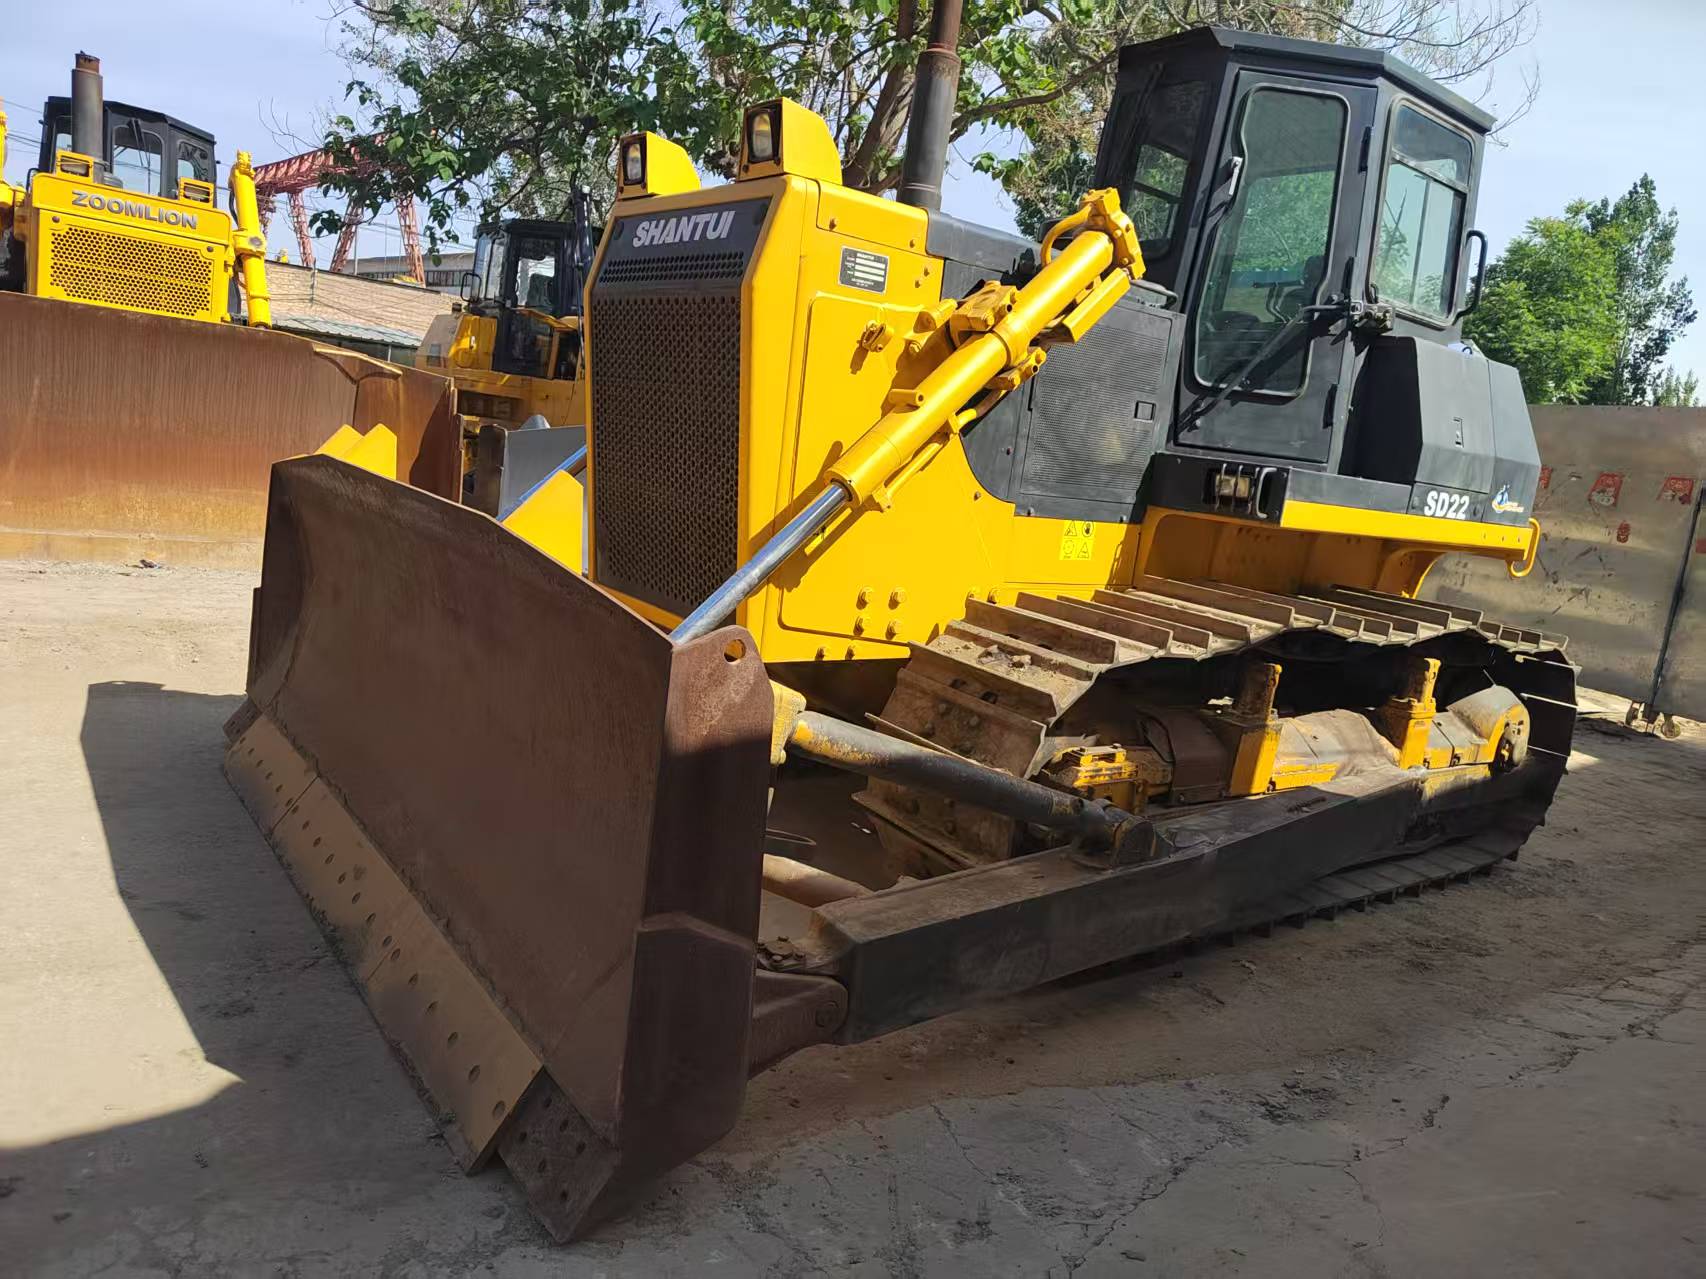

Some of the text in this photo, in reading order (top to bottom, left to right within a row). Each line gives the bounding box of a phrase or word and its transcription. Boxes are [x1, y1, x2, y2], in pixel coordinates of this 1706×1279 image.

[72, 189, 197, 229] ZOOMLION
[633, 211, 736, 248] SHANTUI
[1424, 490, 1469, 520] SD22
